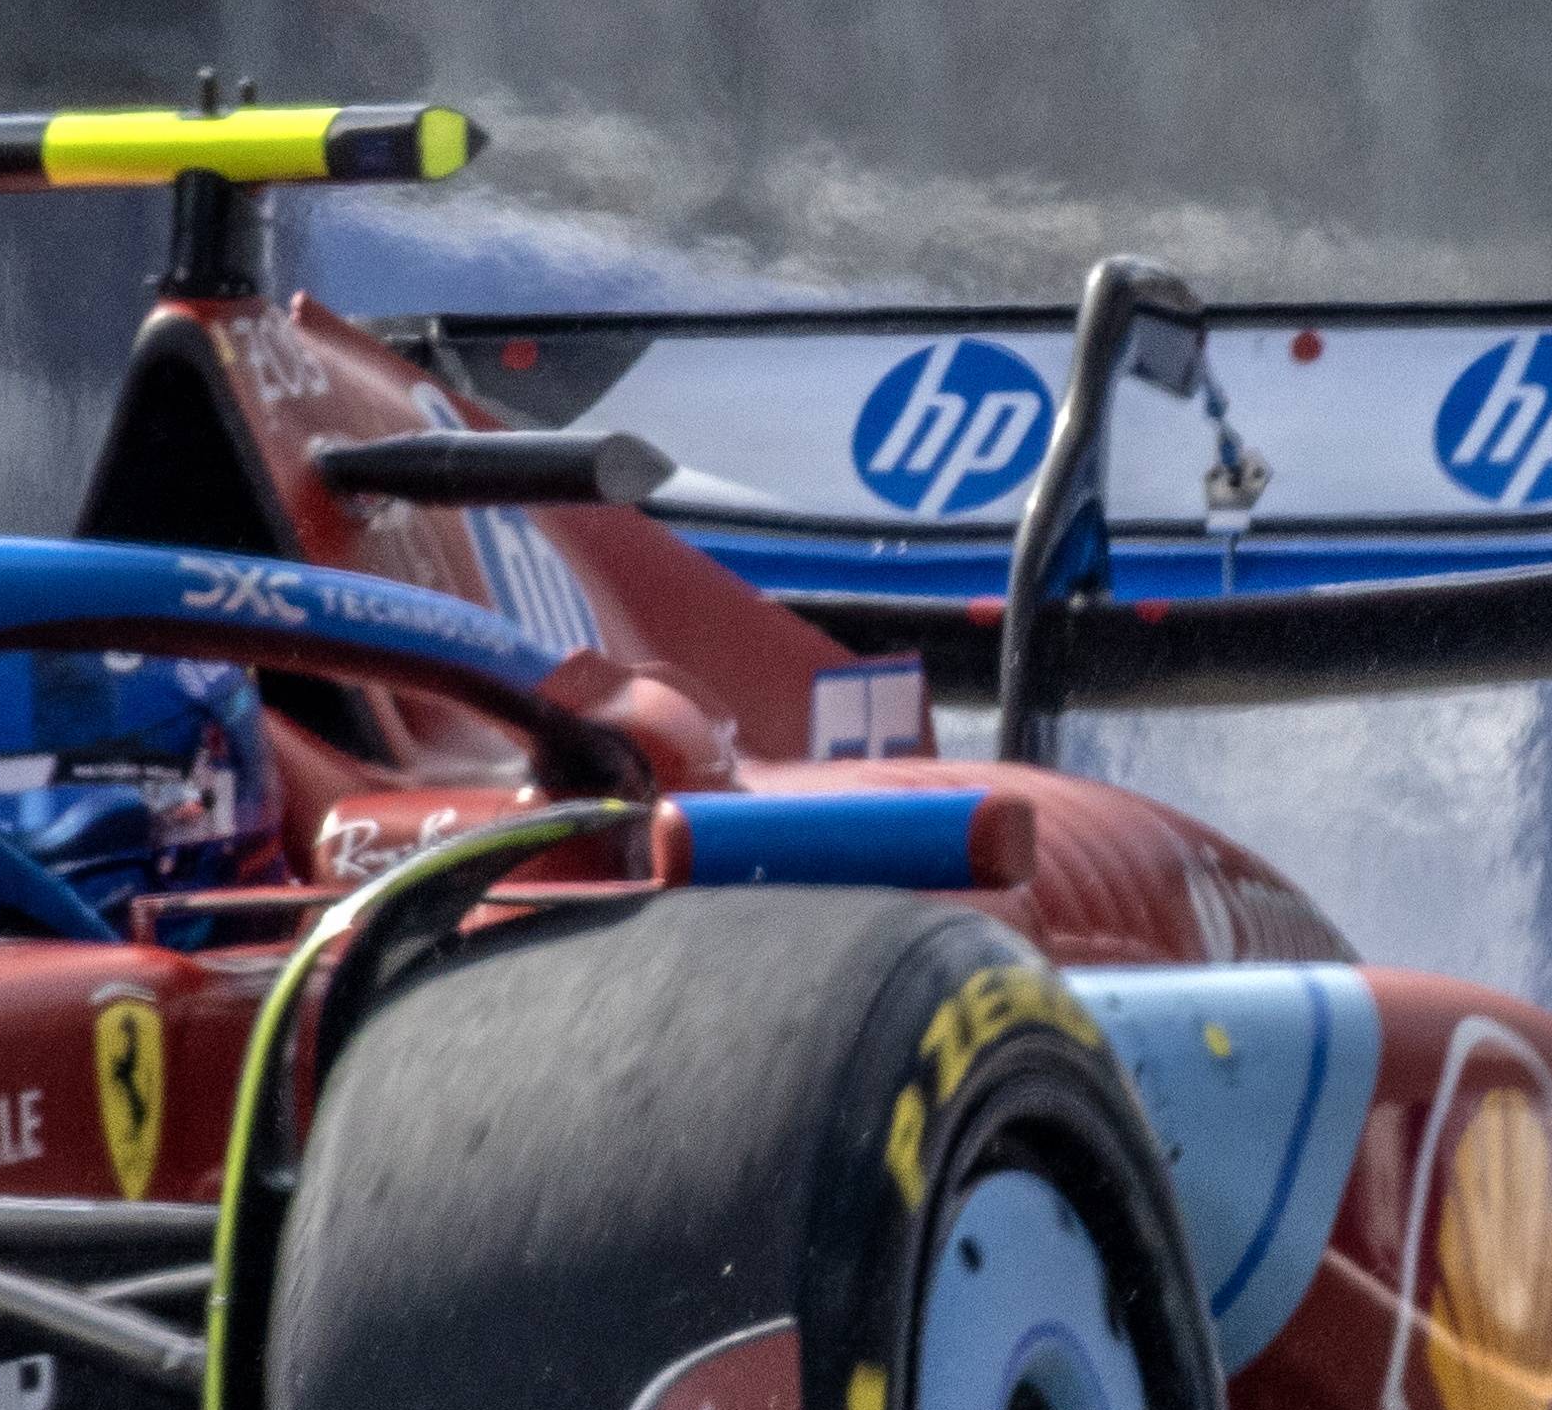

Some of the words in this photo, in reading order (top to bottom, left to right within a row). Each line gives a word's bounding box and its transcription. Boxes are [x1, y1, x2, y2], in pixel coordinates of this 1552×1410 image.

[866, 337, 1046, 516] hp
[177, 553, 308, 625] DXC
[917, 965, 1103, 1105] ZERO
